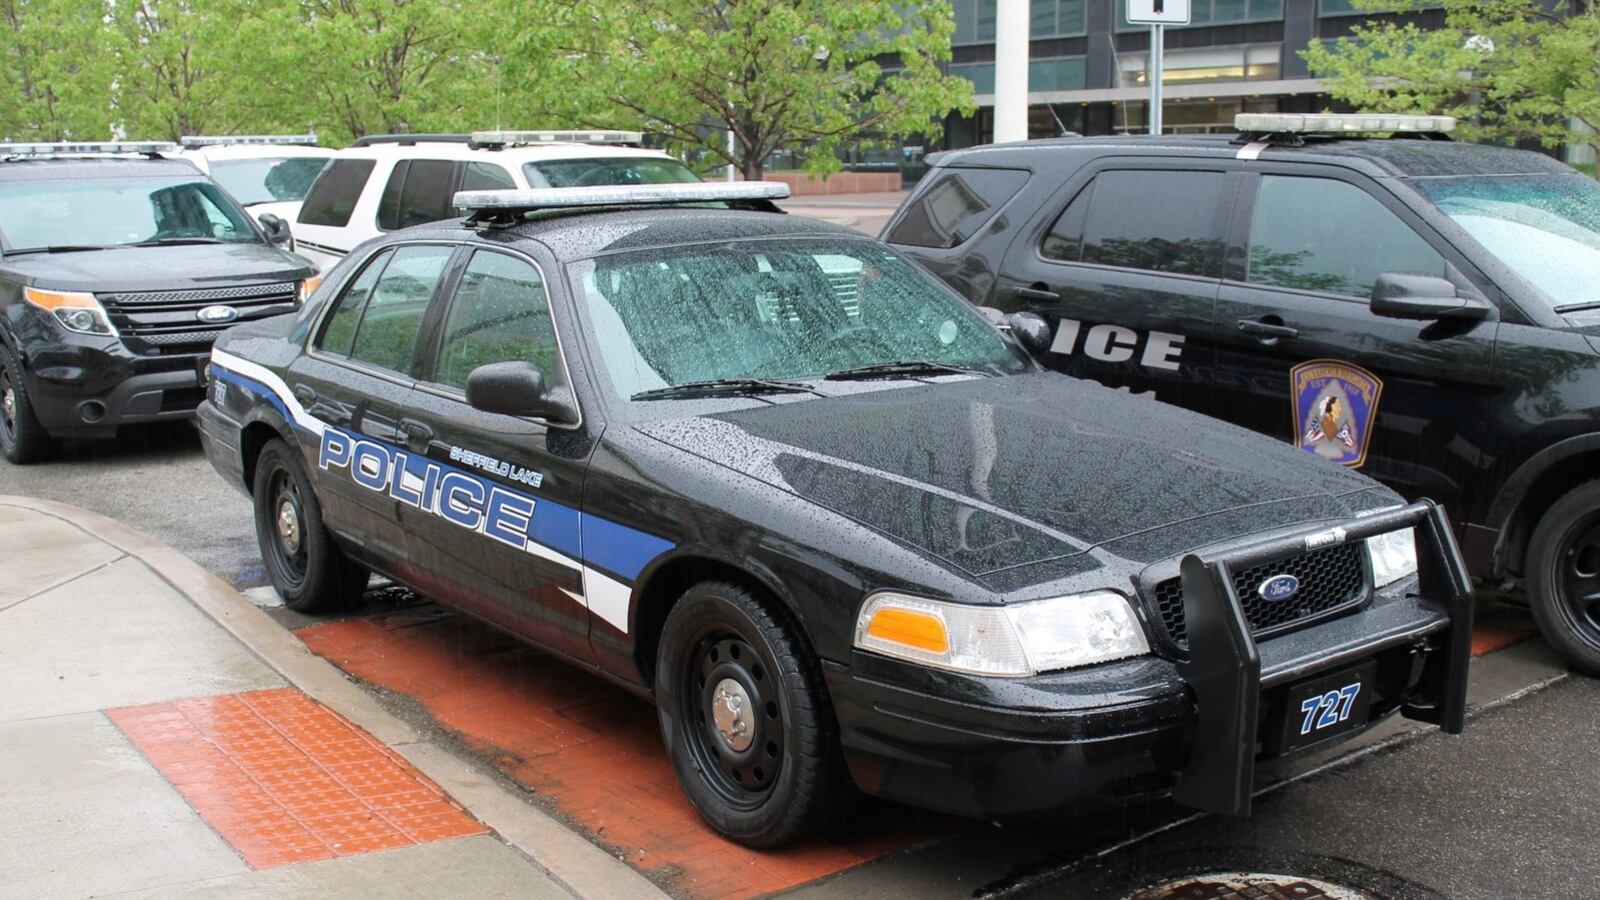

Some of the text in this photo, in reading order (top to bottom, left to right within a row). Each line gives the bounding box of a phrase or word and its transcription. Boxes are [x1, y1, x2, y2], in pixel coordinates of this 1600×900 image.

[319, 425, 536, 551] POLICE
[449, 446, 543, 488] SHEFFIELD LAKE
[1301, 682, 1361, 735] 727
